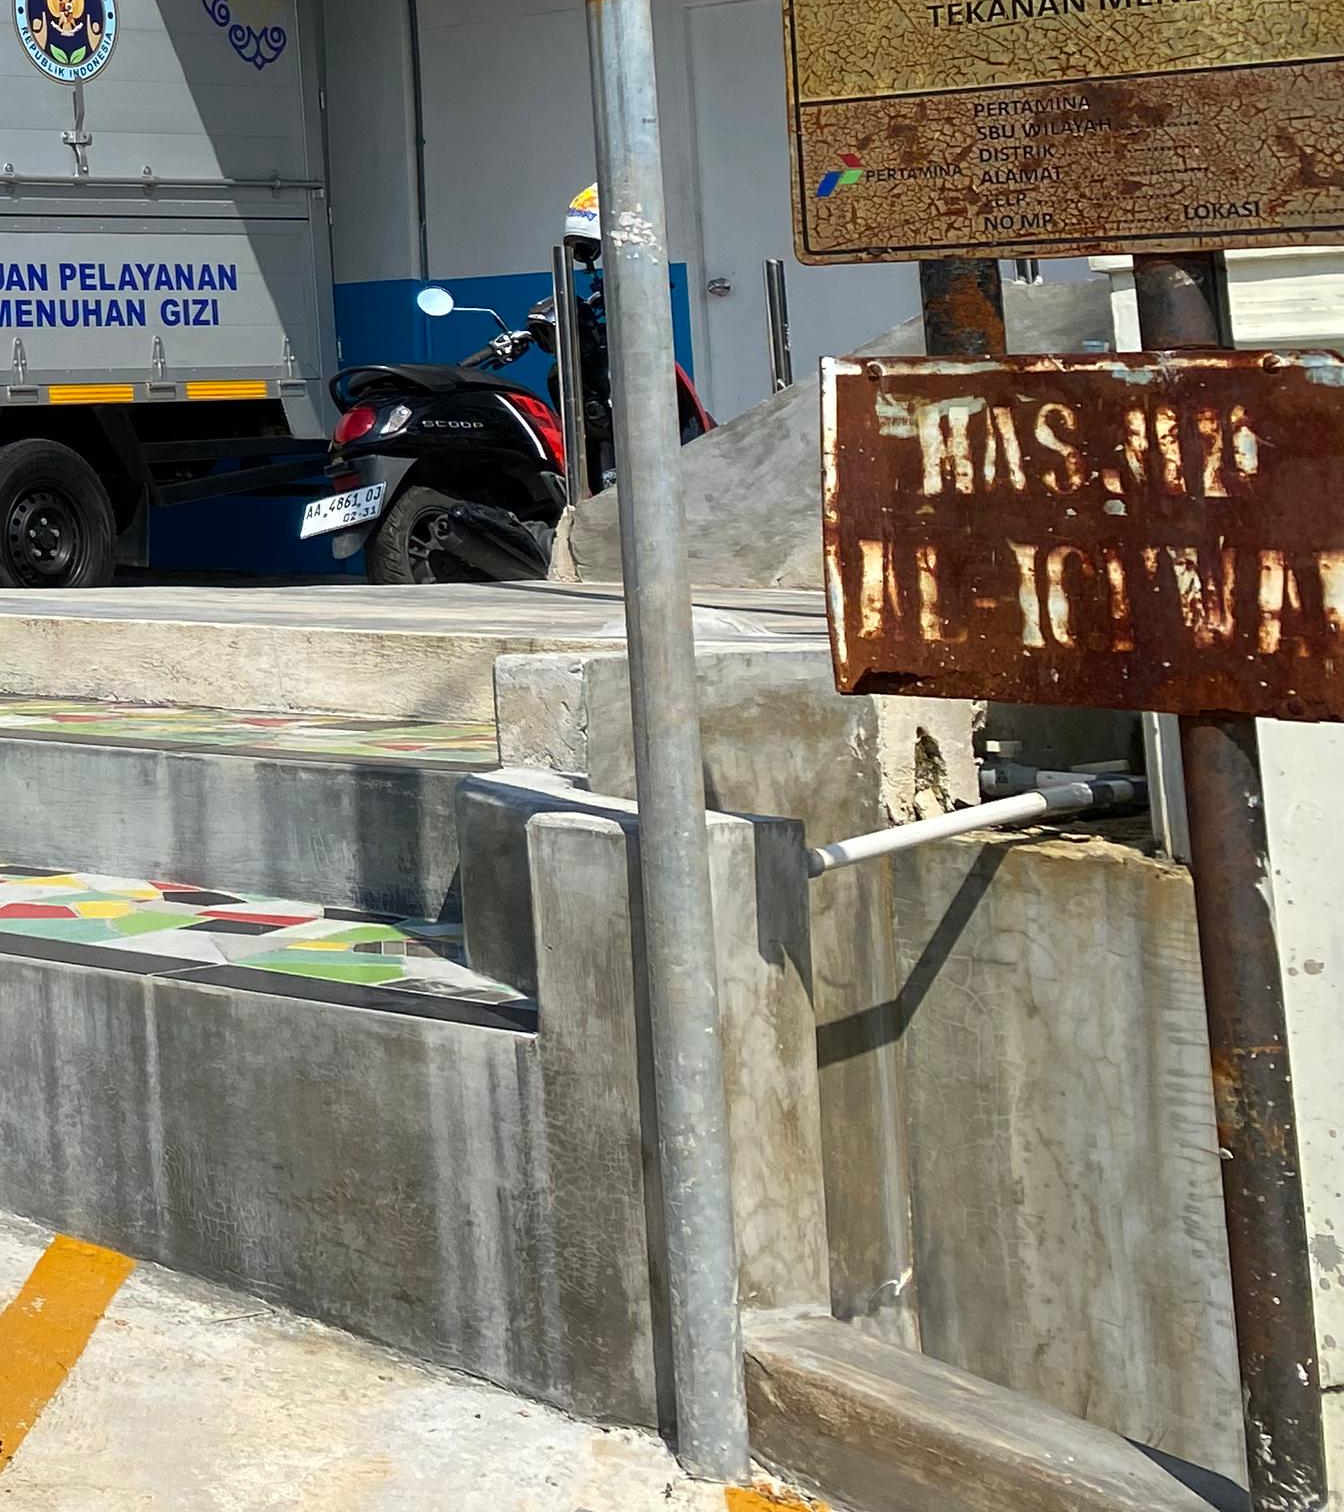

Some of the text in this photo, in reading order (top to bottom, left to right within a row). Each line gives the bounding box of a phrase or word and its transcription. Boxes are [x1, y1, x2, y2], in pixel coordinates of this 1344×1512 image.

[21, 27, 113, 78] REPUBLIK INDONESIA
[974, 95, 1091, 119] PERTAMINA
[1021, 118, 1112, 139] WILAYAH
[979, 142, 1056, 163] DISTRIK
[866, 164, 962, 182] PERTAMINA
[980, 166, 1064, 186] ALAMAT
[984, 214, 1014, 230] NO
[1183, 200, 1261, 220] LOKASI
[59, 263, 238, 292] PELAYANAN
[160, 298, 220, 327] GIZI
